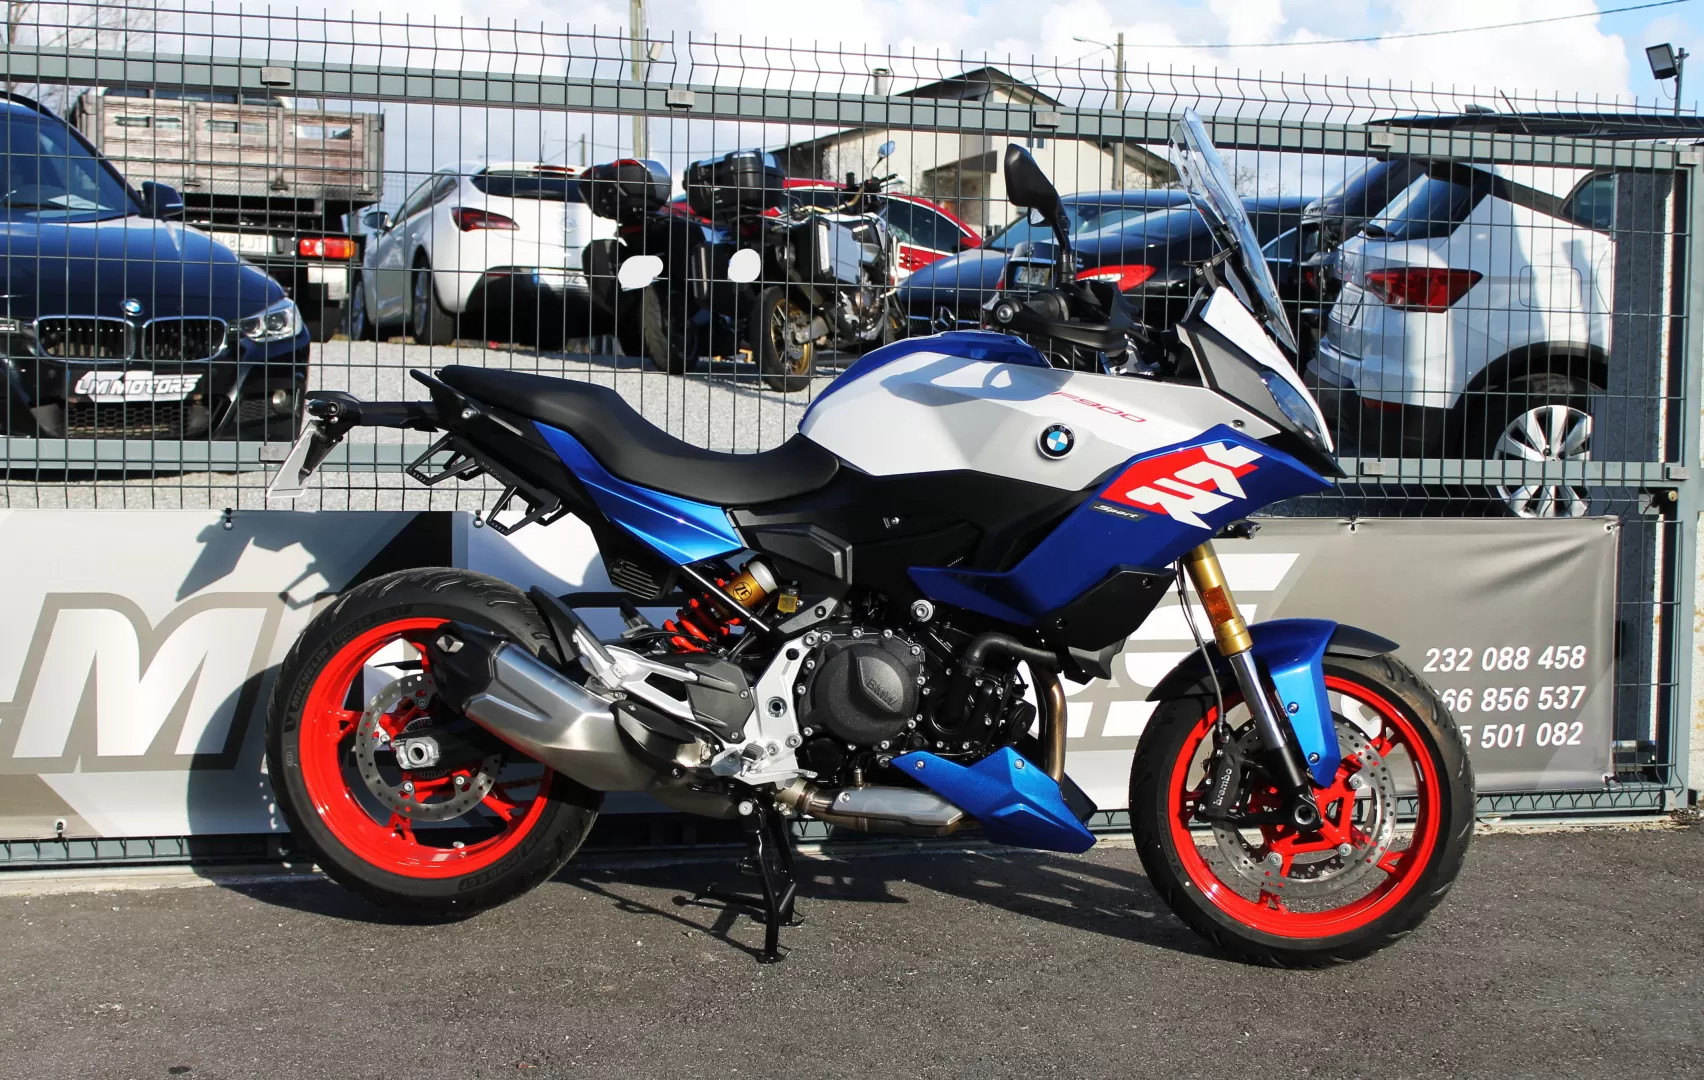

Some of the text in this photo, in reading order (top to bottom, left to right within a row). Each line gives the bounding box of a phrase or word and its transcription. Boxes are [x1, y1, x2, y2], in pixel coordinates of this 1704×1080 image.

[109, 379, 197, 395] MOTORS
[1047, 426, 1074, 440] BMW
[1094, 503, 1140, 519] Sport
[1423, 645, 1587, 672] 232 088 458
[0, 607, 269, 759] M
[1433, 685, 1587, 713] 66 856 537
[1480, 723, 1526, 749] 501
[1536, 721, 1584, 747] 082
[1213, 768, 1233, 806] brembo
